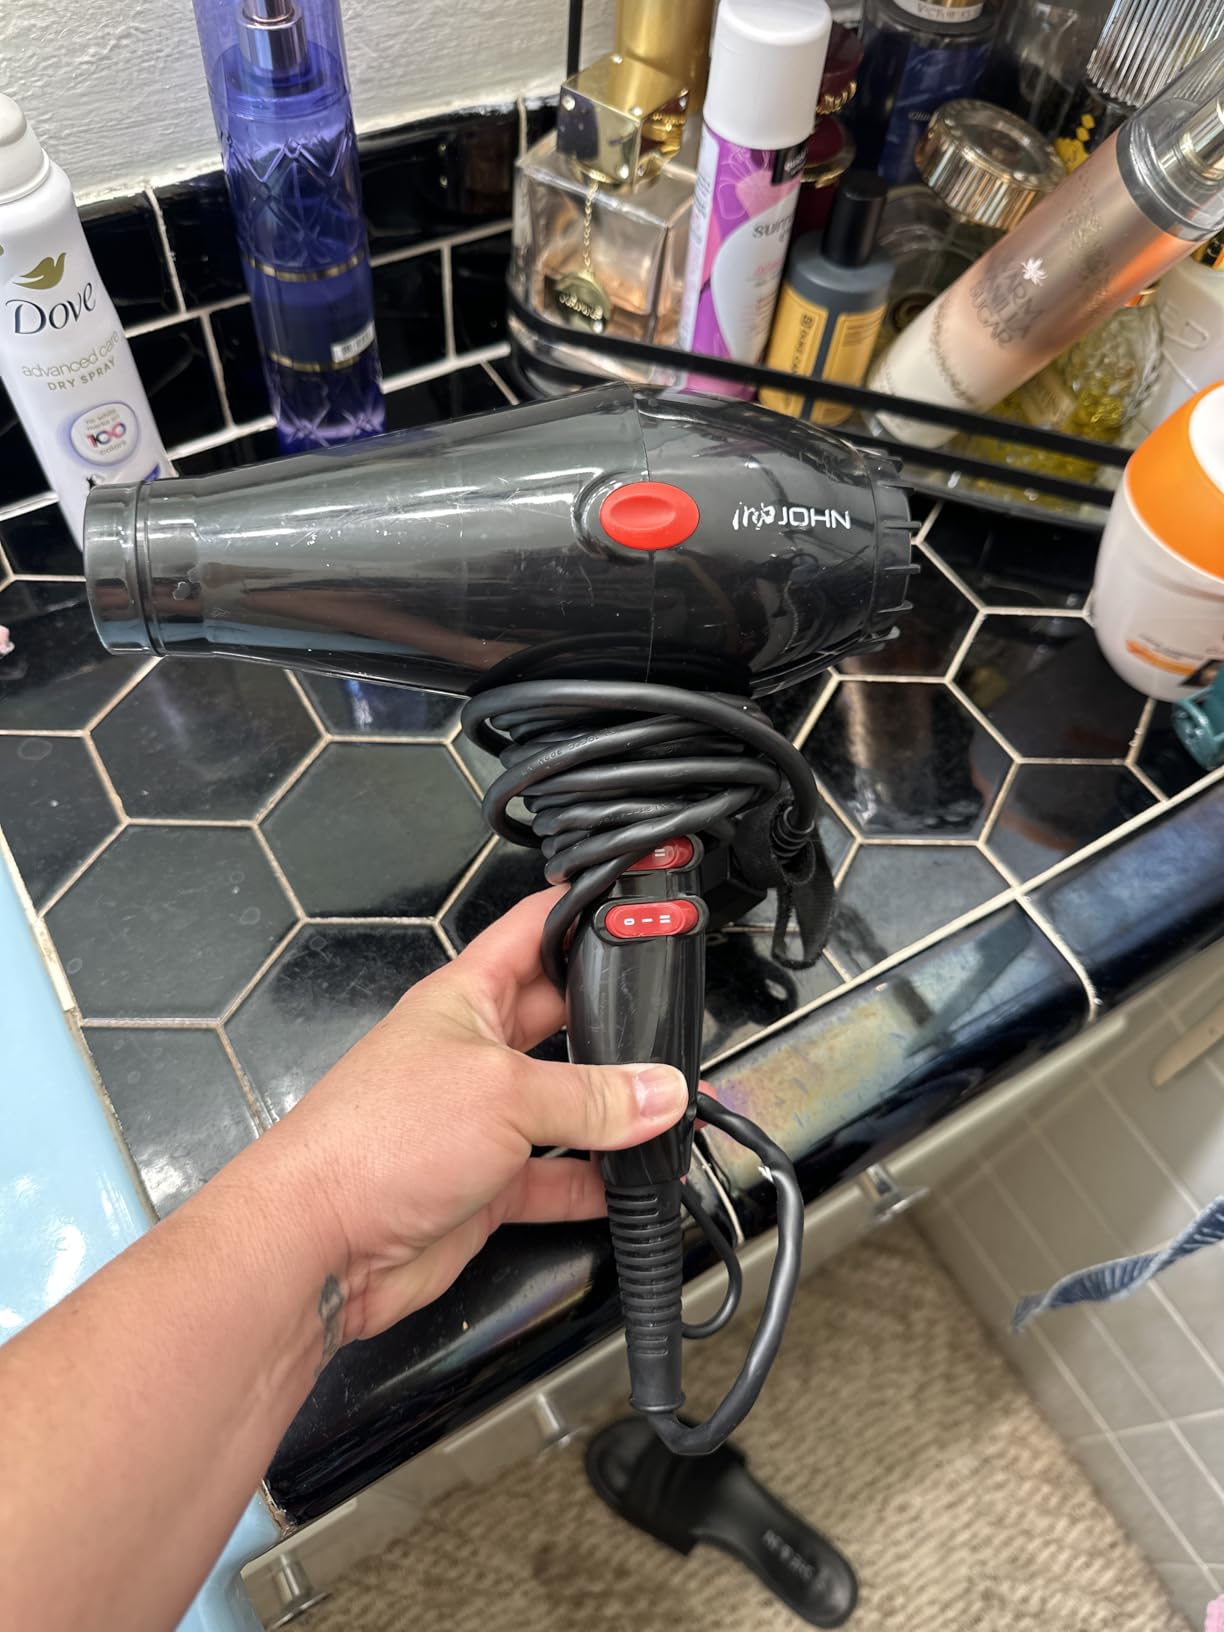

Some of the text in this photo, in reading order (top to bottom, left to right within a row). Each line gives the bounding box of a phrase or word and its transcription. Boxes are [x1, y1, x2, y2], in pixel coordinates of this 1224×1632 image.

[5, 282, 96, 335] Dove
[21, 330, 120, 377] advanced care
[47, 356, 116, 391] DRY SPRAY
[86, 420, 127, 448] 100
[778, 506, 851, 529] JOHN
